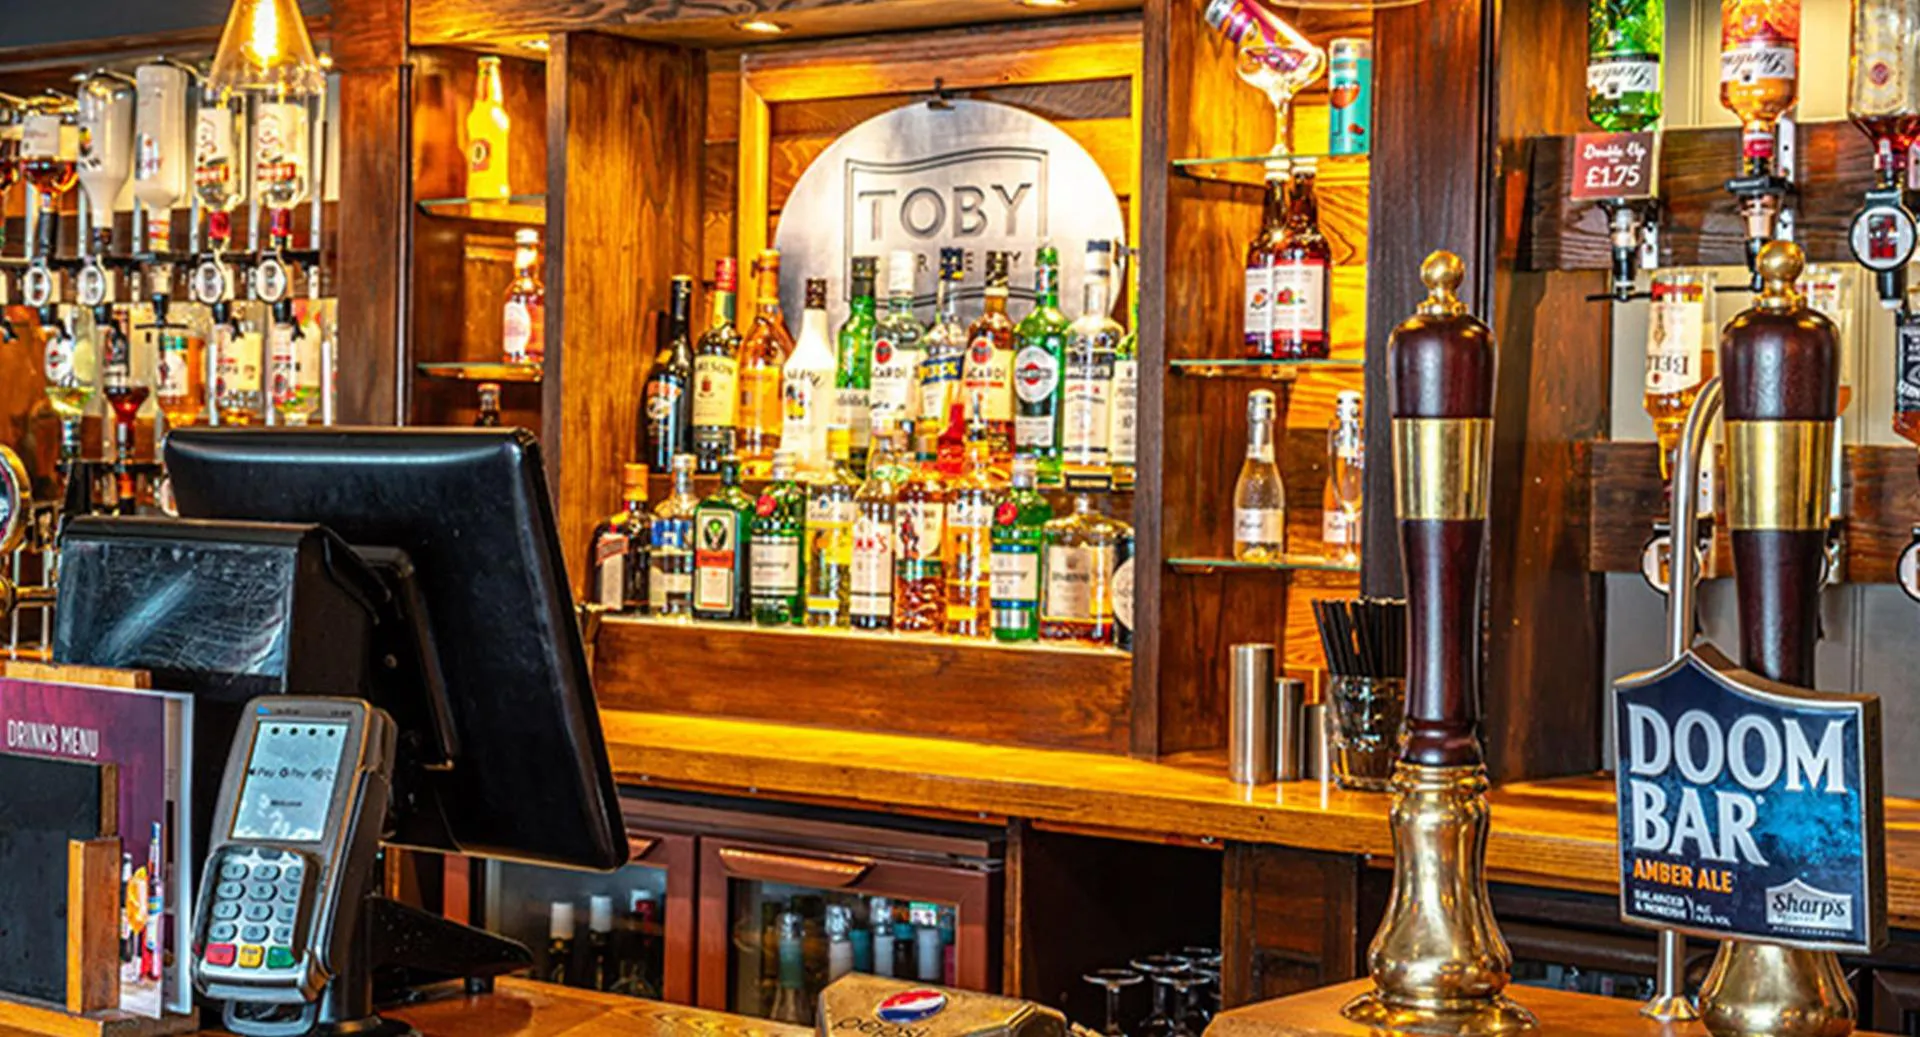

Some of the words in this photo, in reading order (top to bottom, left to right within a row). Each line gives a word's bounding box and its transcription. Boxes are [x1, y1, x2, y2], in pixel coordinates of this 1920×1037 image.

[1583, 143, 1623, 160] Double
[1626, 141, 1647, 162] Up
[1585, 165, 1640, 188] £1.75
[858, 182, 1033, 241] TOBY
[7, 719, 58, 753] DRINKS
[61, 726, 99, 757] MENU
[1626, 703, 1848, 793] DOOM
[1629, 778, 1770, 867] BAR
[1633, 858, 1694, 888] AMBER
[1696, 868, 1733, 894] ALE
[1772, 892, 1846, 921] Sharp's
